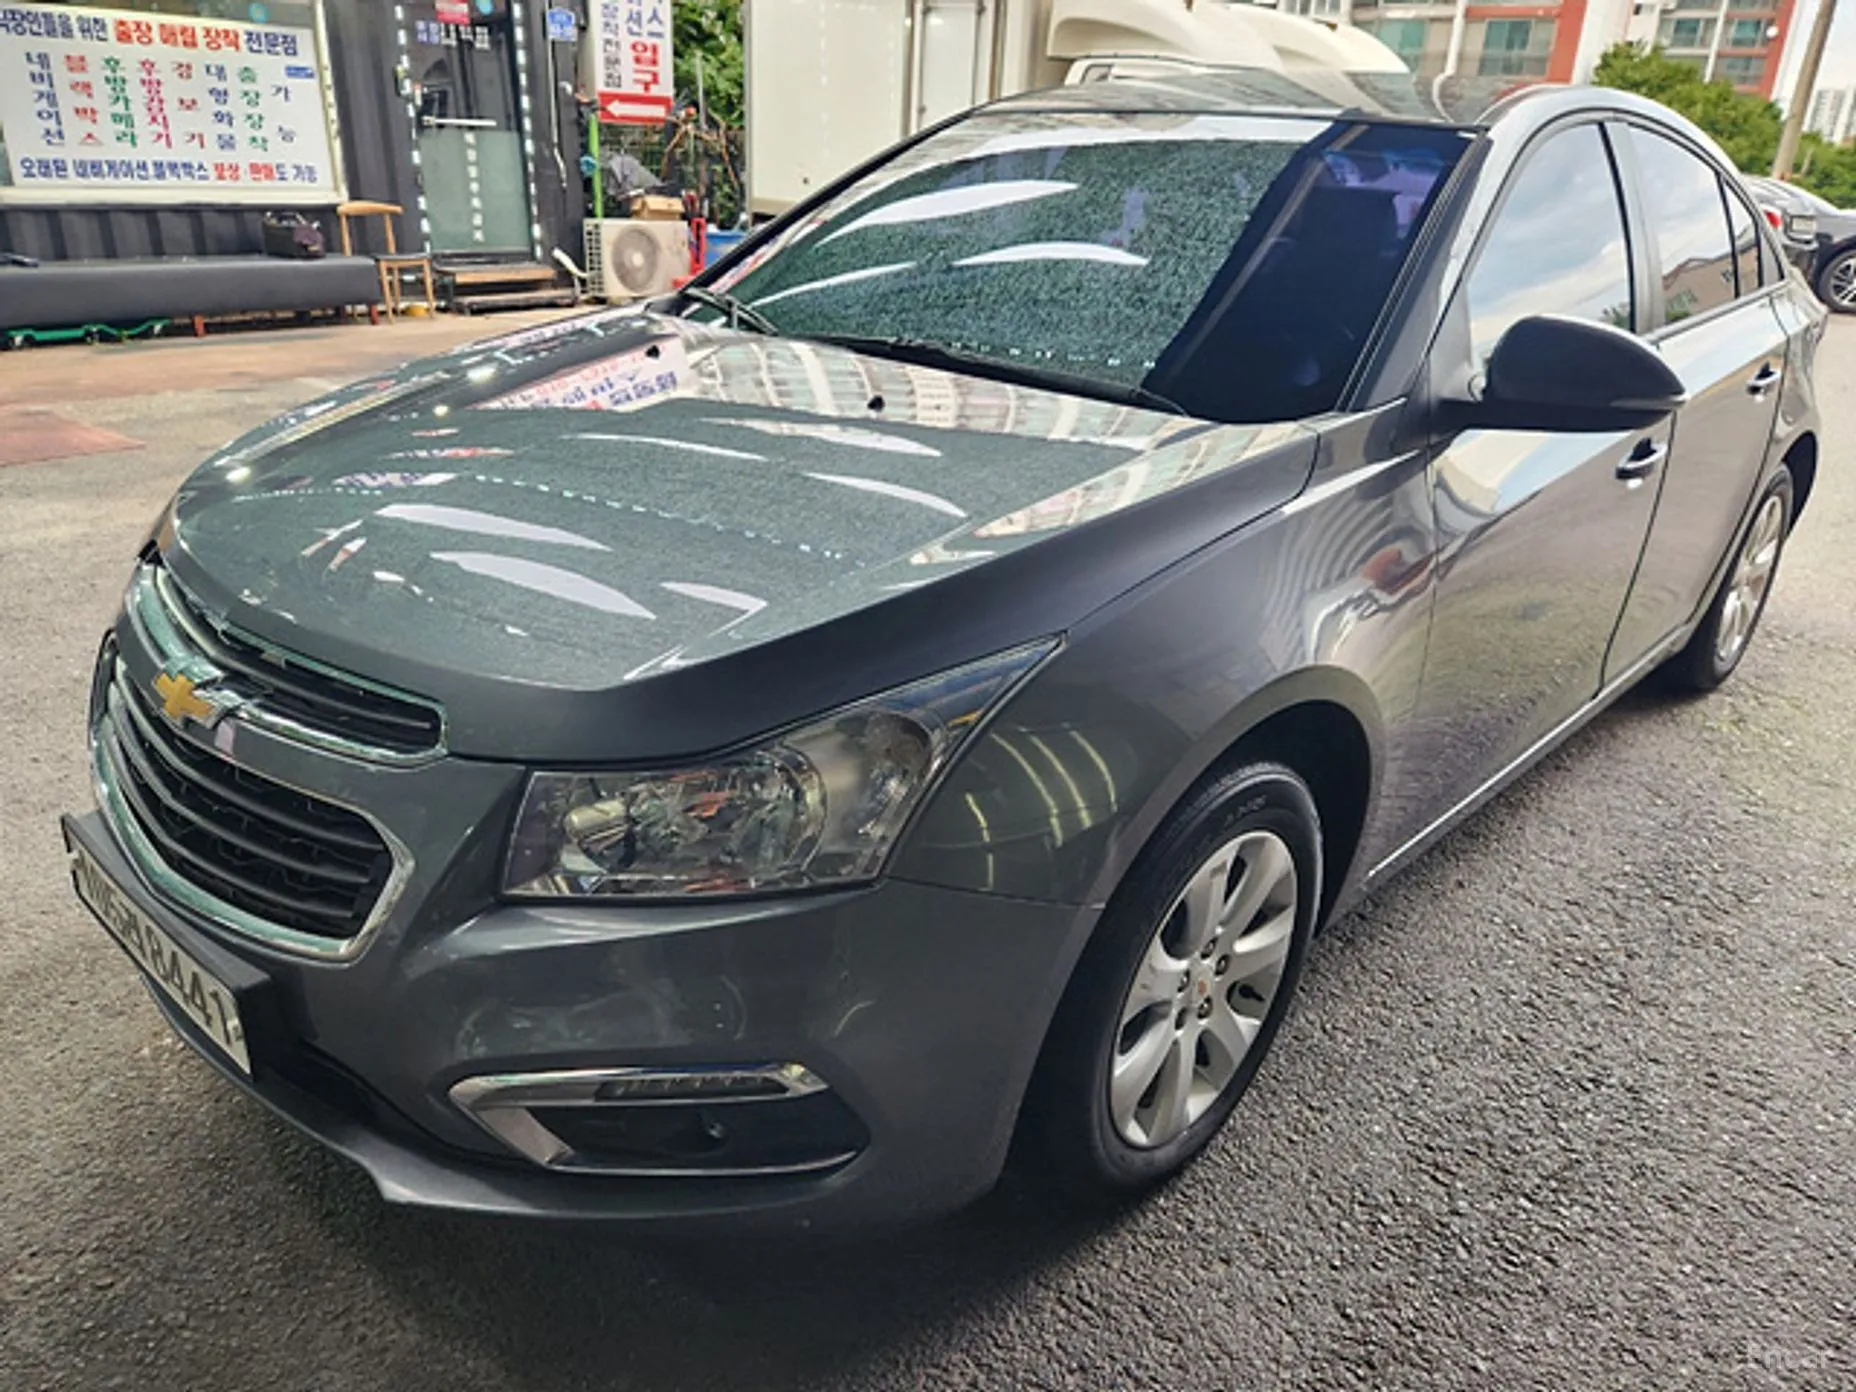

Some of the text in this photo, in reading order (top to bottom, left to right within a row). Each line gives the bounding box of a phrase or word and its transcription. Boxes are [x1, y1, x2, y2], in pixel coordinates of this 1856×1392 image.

[76, 15, 108, 42] 위한
[114, 18, 153, 45] 출장
[202, 26, 241, 52] 장착
[245, 31, 298, 56] 전문점
[630, 41, 660, 93] 입구
[20, 156, 68, 179] 오래된
